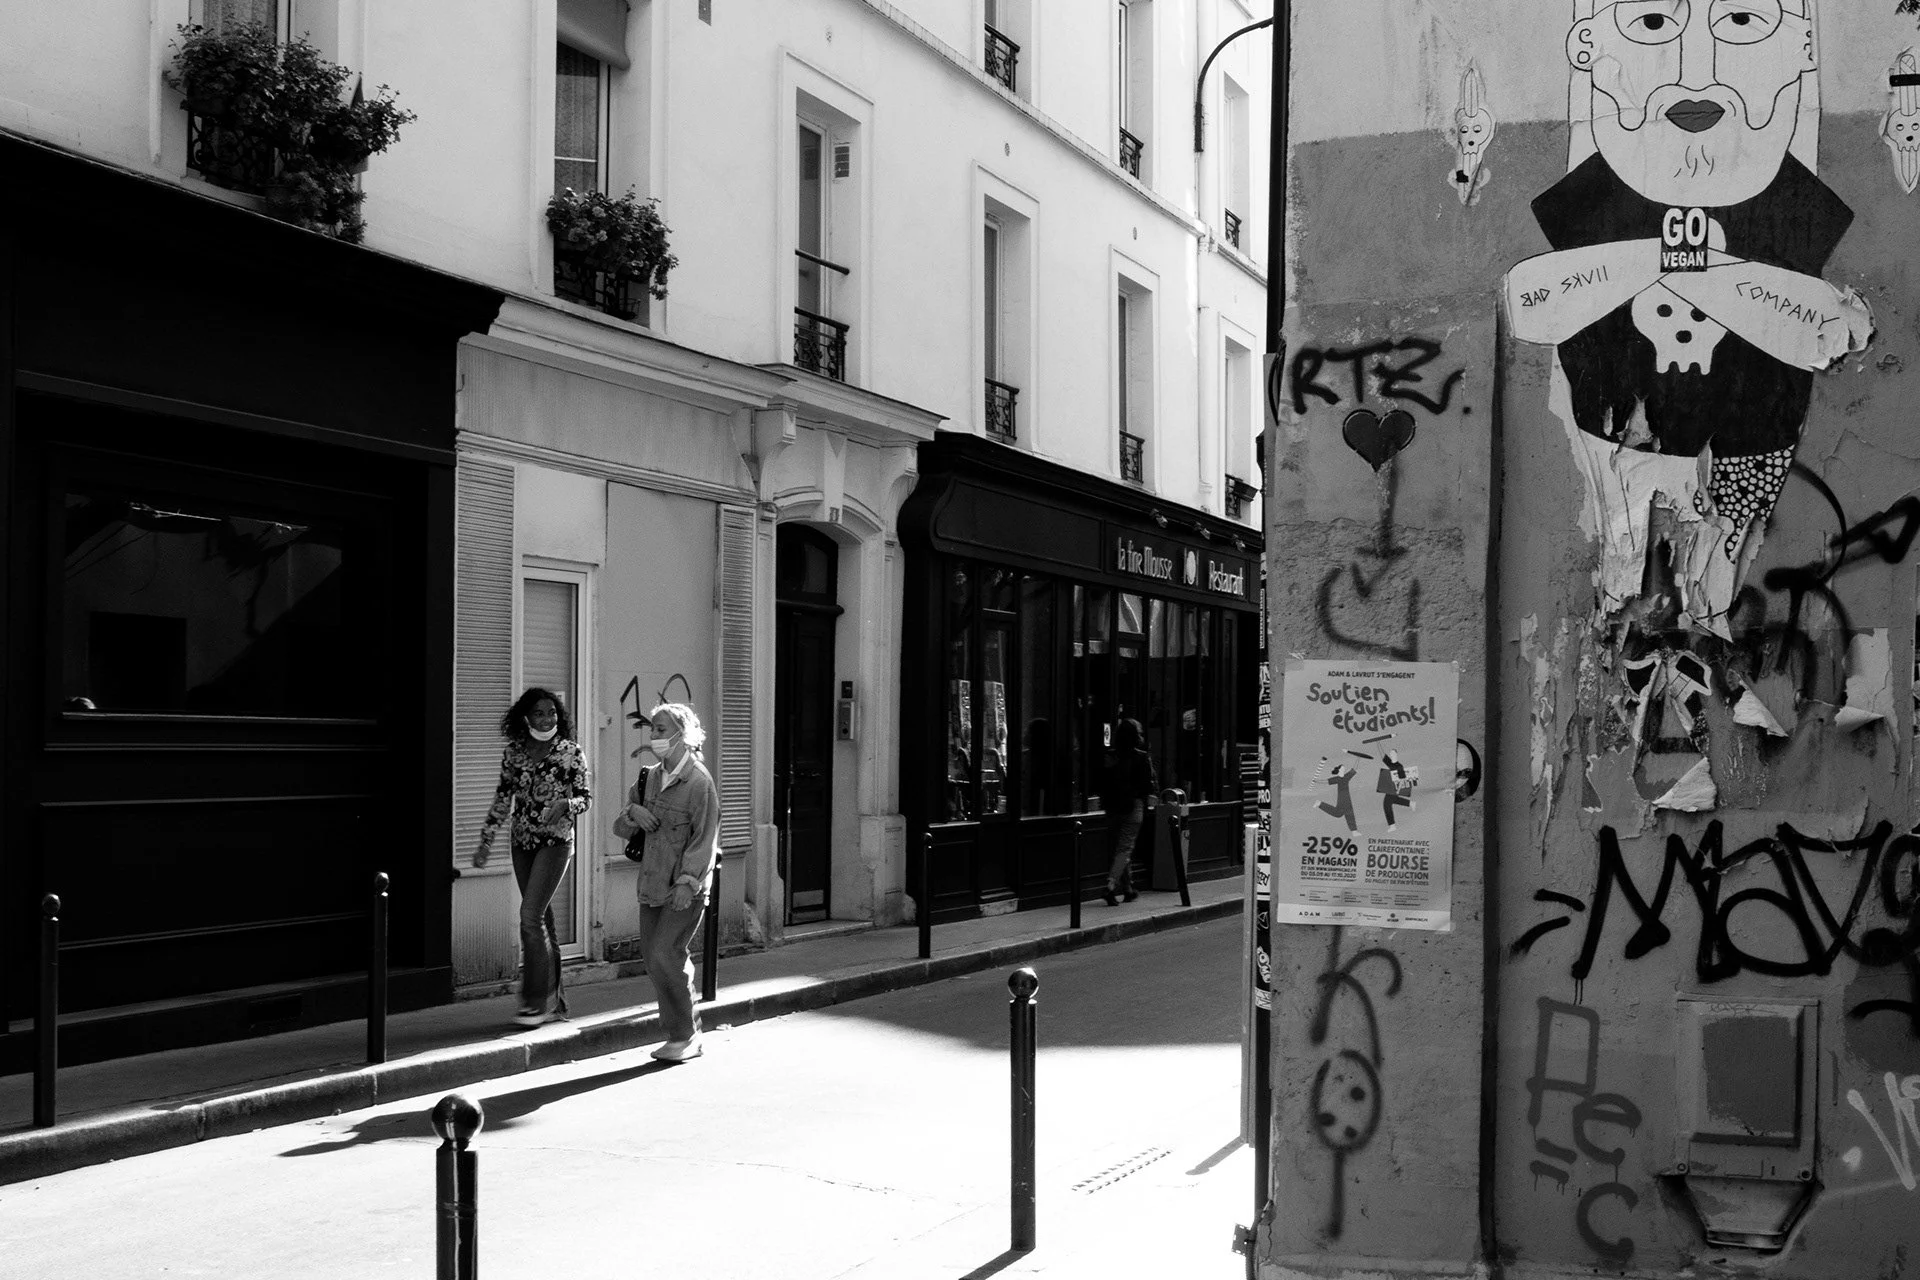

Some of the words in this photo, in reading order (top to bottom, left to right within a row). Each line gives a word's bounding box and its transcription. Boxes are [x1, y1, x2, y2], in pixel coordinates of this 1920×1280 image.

[1662, 207, 1707, 247] GO
[1662, 251, 1705, 268] VEGAN
[1519, 288, 1551, 307] BAD
[1734, 281, 1841, 331] COMPANY
[1118, 537, 1126, 571] la
[1144, 546, 1173, 581] Mousse
[1208, 560, 1244, 596] Restaurant
[1327, 670, 1345, 678] ADAM
[1306, 682, 1390, 705] Soutien
[1332, 696, 1436, 734] étudiants!
[1353, 701, 1388, 716] aux
[1302, 836, 1358, 857] -25%
[1367, 845, 1425, 855] CLAIREFONTAINE
[1377, 838, 1414, 846] PARTENARIAT
[1301, 856, 1315, 866] EN
[1317, 856, 1358, 868] MAGASIN
[1366, 853, 1430, 871] BOURSE
[1365, 869, 1376, 878] DE
[1377, 870, 1429, 880] PRODUCTION
